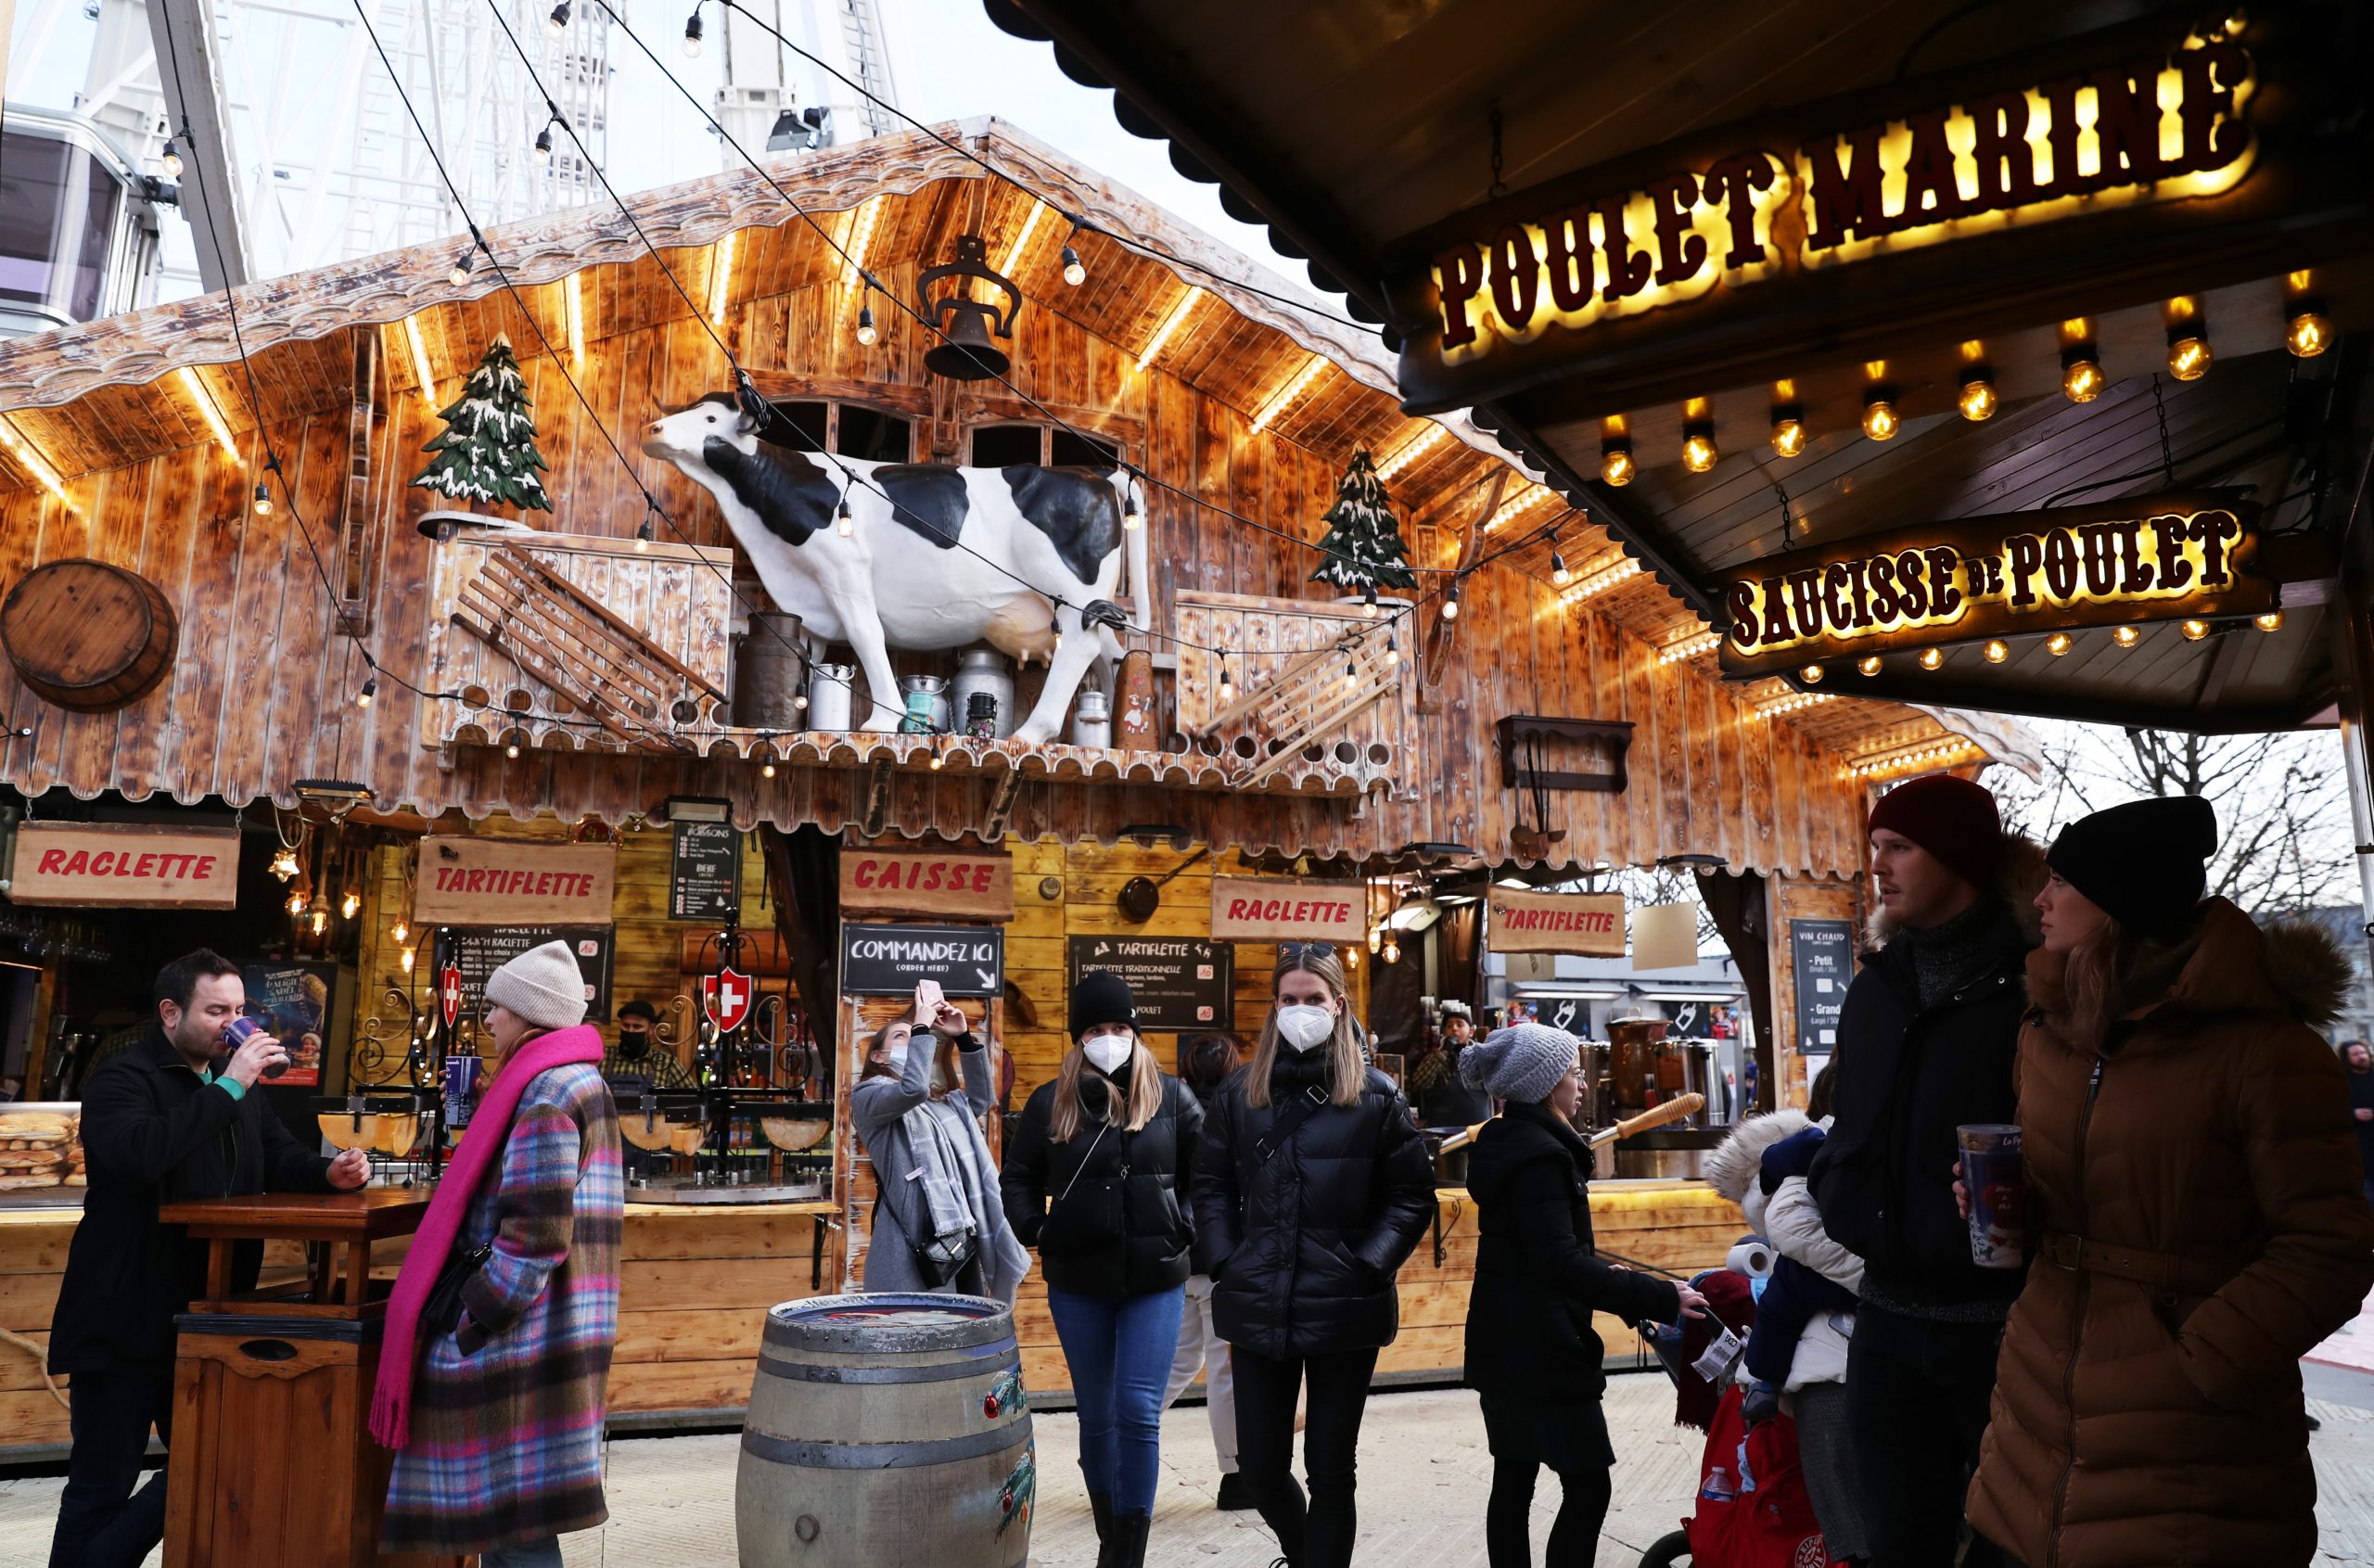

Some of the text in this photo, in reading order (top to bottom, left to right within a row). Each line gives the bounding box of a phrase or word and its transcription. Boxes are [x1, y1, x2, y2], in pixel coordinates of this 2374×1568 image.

[1435, 151, 1775, 351] POULET
[1729, 511, 2238, 647] SAUCISSE DE POULET
[37, 848, 217, 882] RACLETTE
[436, 867, 595, 899] TARTIFLETTE
[854, 859, 995, 893] CAISSE
[1227, 897, 1352, 925] RACLETTE
[1503, 907, 1615, 935] TARTIFLETTE
[491, 937, 530, 948] RACLETTE
[1799, 932, 1844, 941] VIN CHAUD
[851, 939, 993, 962] COMMANDEZ ICI
[1117, 942, 1189, 957] TARTIFLETTE
[896, 963, 950, 973] (ORDER HERE)
[1814, 955, 1833, 966] Petit
[1125, 964, 1182, 975] TRADITIONNELLE
[1136, 1006, 1161, 1015] POULET
[1817, 1003, 1841, 1014] Grand
[1725, 1334, 1738, 1347] CDG
